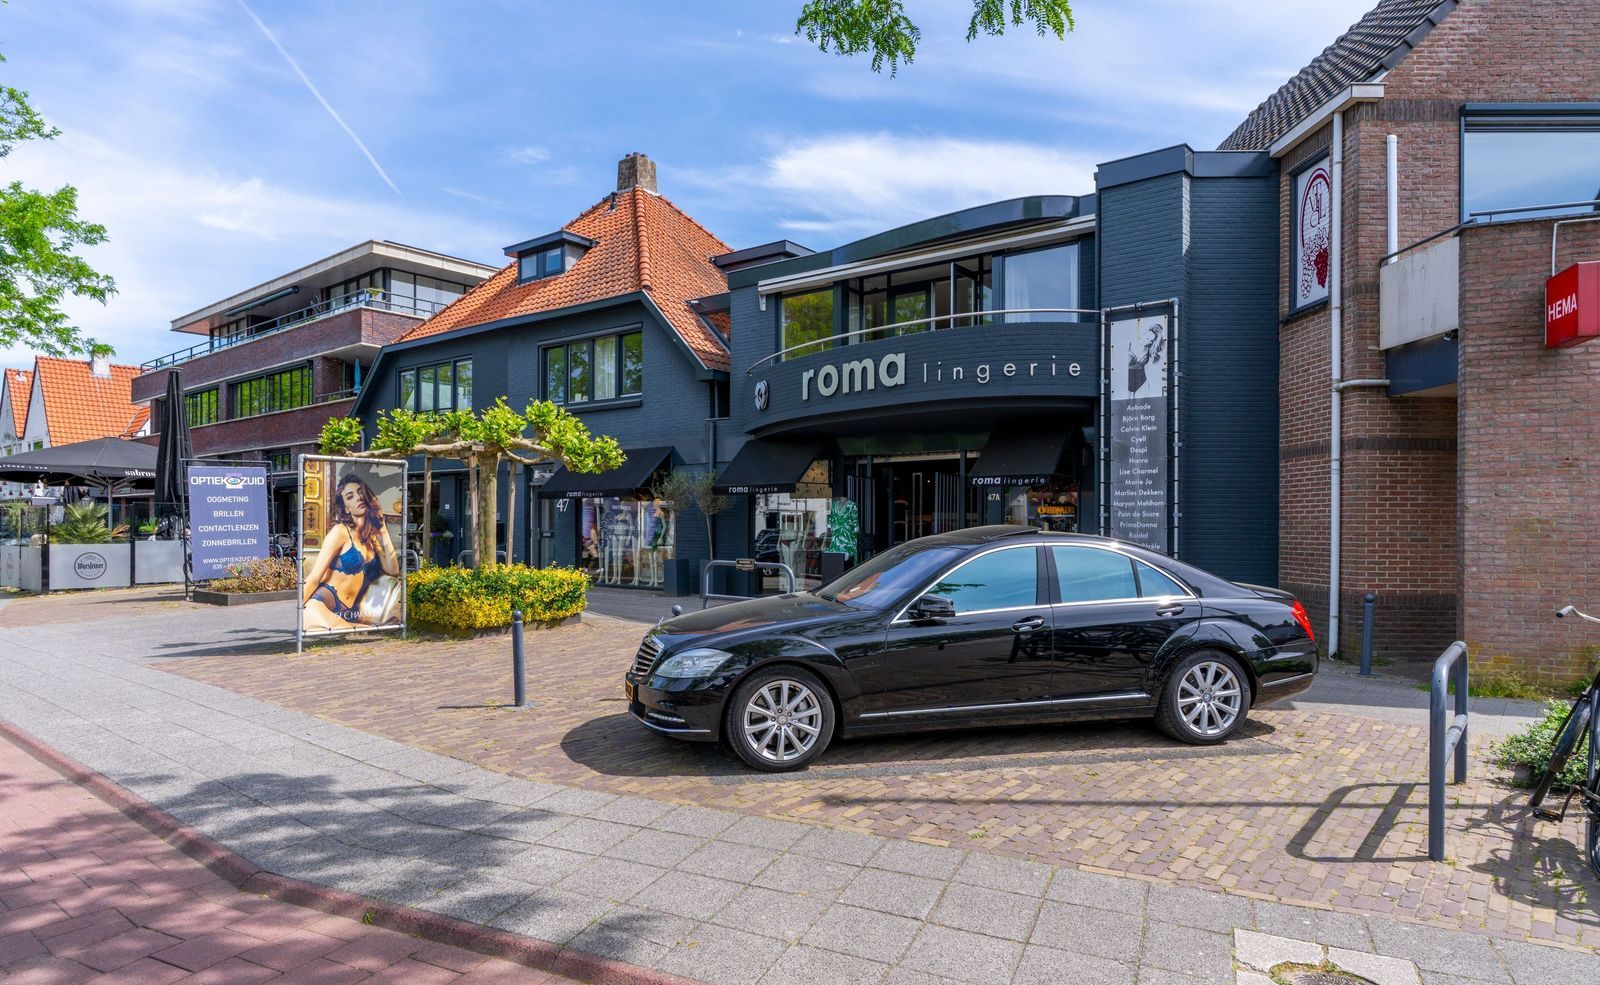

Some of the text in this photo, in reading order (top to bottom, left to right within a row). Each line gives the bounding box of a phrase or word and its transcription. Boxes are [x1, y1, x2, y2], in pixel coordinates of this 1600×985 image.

[1548, 293, 1578, 322] HEMA
[802, 352, 1082, 400] roma lingerie
[190, 476, 265, 486] OPTIEK ZUID
[972, 477, 1046, 486] roma lingerie
[987, 493, 1001, 502] 47A
[556, 498, 570, 512] 47
[213, 510, 245, 518] BRILLEN
[198, 524, 259, 533] CONTACTLENZEN
[202, 538, 257, 547] ZONNEBRILLEN
